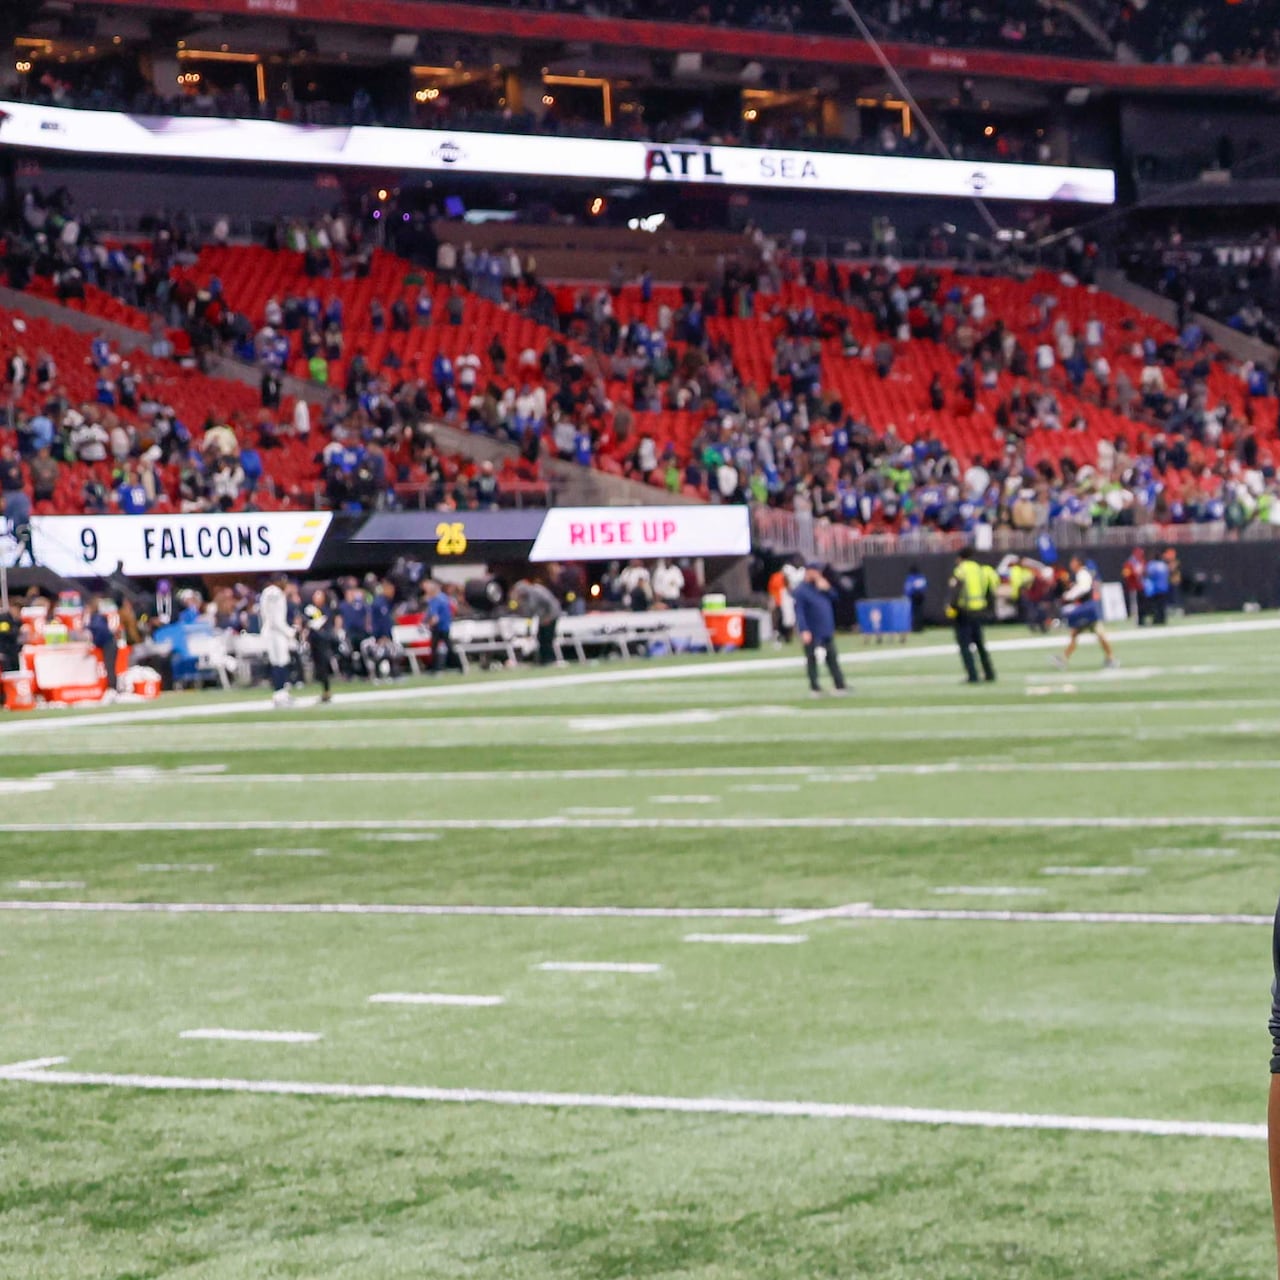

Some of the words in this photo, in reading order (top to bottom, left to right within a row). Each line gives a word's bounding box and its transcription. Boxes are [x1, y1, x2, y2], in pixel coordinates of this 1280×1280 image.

[646, 148, 724, 177] ATL
[759, 156, 819, 181] SEA
[79, 527, 99, 562] 9
[143, 525, 272, 560] FALCONS
[435, 522, 468, 555] 25
[569, 522, 632, 547] RISE
[643, 520, 677, 544] UP
